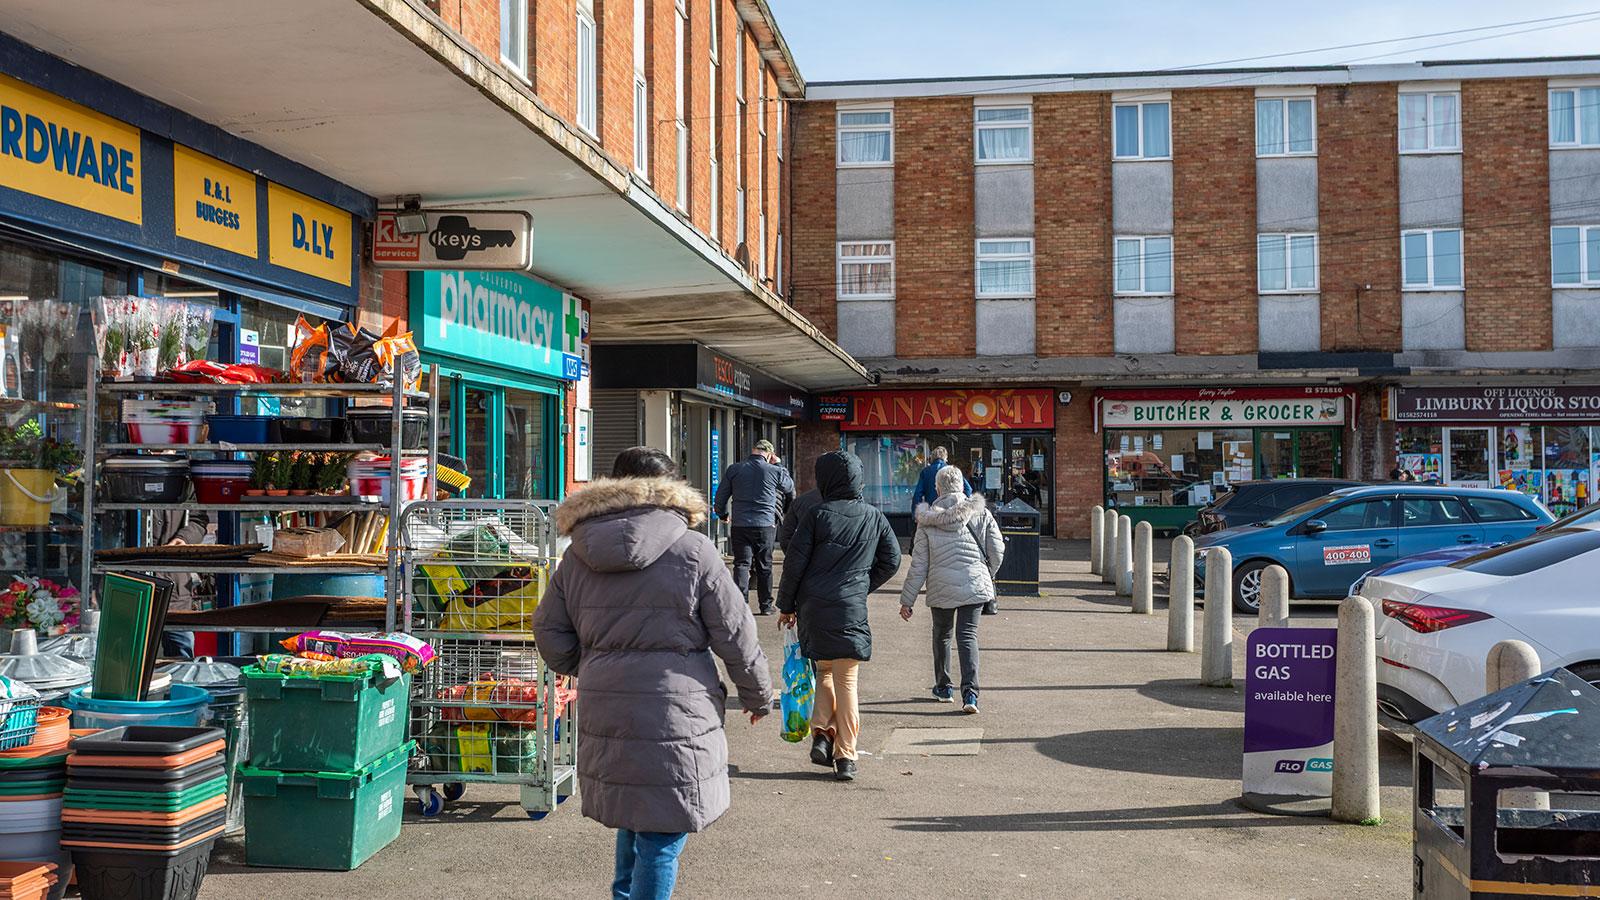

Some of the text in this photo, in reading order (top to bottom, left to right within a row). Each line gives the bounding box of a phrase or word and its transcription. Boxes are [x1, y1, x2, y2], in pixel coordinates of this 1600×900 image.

[1, 105, 135, 195] RDWARE
[196, 200, 240, 230] BURGESS
[437, 231, 482, 248] keys
[376, 250, 417, 258] services
[480, 271, 523, 294] CALVERTON
[440, 270, 554, 365] pharmacy
[566, 357, 578, 377] NHS
[713, 356, 751, 395] TESCO express
[1484, 388, 1556, 397] OFF LICENCE
[851, 394, 1049, 426] TANATOMY
[1134, 405, 1315, 421] BUTCHER & GROCER
[1415, 397, 1495, 411] LIMBURY
[1499, 397, 1566, 413] LIQUOR
[1255, 643, 1335, 659] BOTTLED
[1255, 666, 1291, 680] GAS
[1254, 691, 1332, 702] available here
[1279, 760, 1333, 771] FLO GAS
